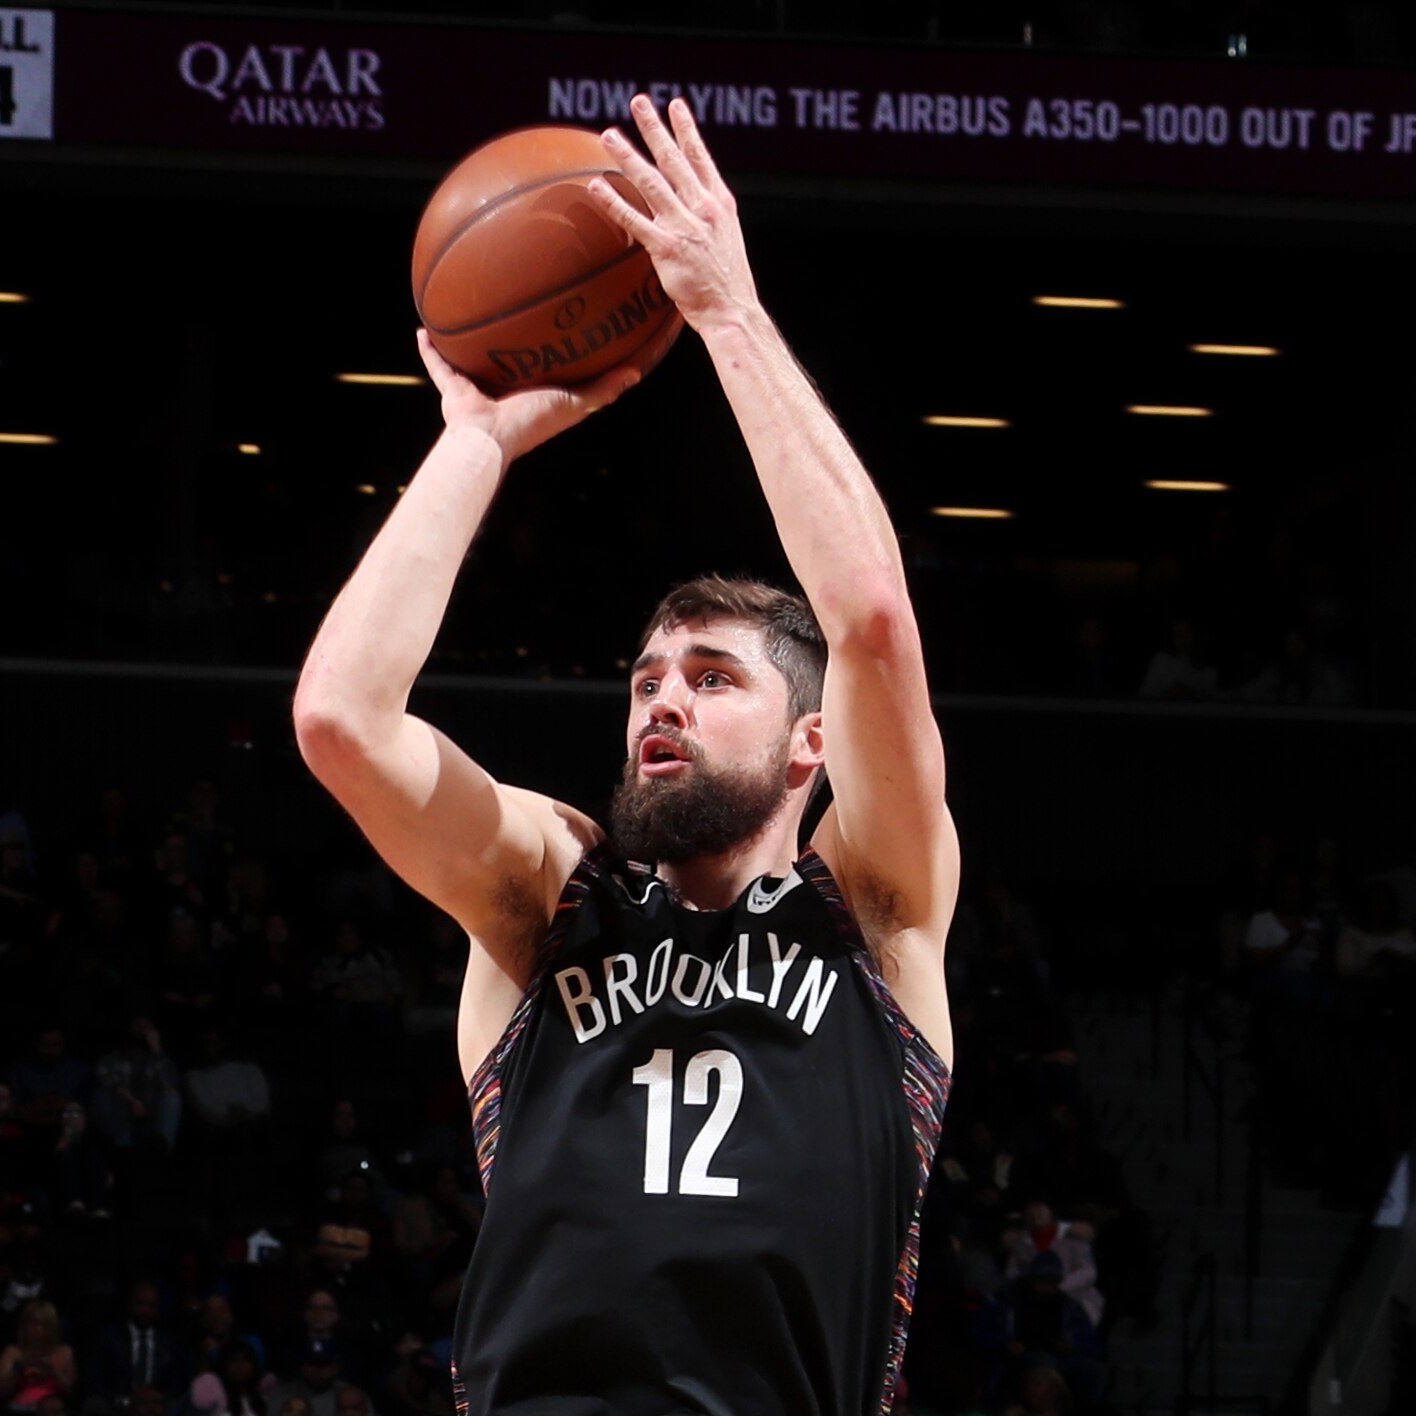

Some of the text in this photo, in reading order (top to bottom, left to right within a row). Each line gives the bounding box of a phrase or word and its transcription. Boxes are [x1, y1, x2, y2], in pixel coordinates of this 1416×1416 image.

[177, 40, 385, 99] QATAR
[229, 95, 385, 133] AIRWAYS
[546, 79, 637, 119] NOW
[788, 86, 860, 130] THE
[871, 92, 1011, 138] AIRBUS
[1023, 97, 1230, 145] A350-1000
[1240, 107, 1318, 149] OUT
[1327, 111, 1375, 152] OF
[554, 932, 840, 1044] BROOKLYN
[632, 1048, 745, 1197] 12
